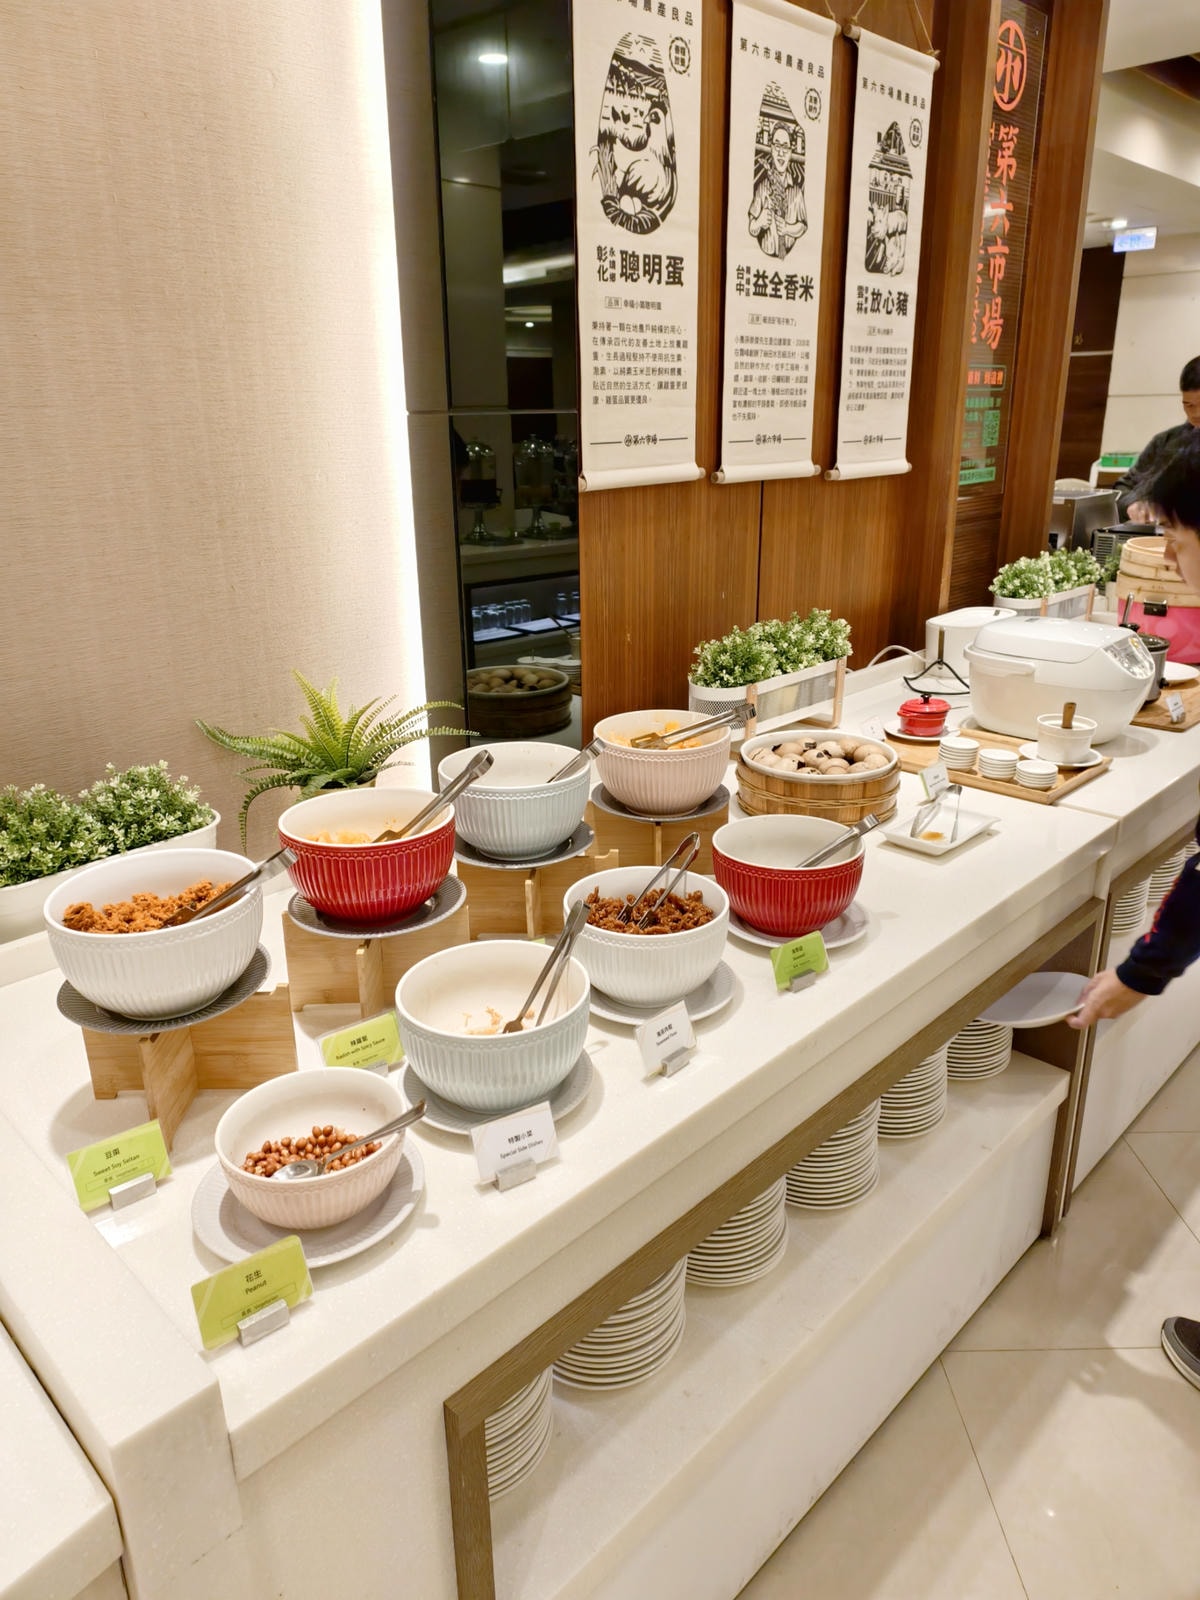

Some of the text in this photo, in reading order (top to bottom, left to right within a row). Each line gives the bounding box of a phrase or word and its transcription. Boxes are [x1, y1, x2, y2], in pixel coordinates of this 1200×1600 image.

[739, 37, 825, 79] 第六市場農產良品
[981, 125, 1019, 350] 第六市場
[597, 245, 608, 282] 彰化
[620, 250, 684, 287] 聰明蛋
[736, 264, 745, 296] 台中
[753, 269, 814, 302] 益全香米
[870, 288, 909, 316] 放心豬
[500, 1139, 544, 1160] Special Side Dishes
[93, 1165, 111, 1178] Sweet
[111, 1160, 122, 1171] Soy
[245, 1269, 262, 1283] 花生
[245, 1279, 268, 1295] Peanut
